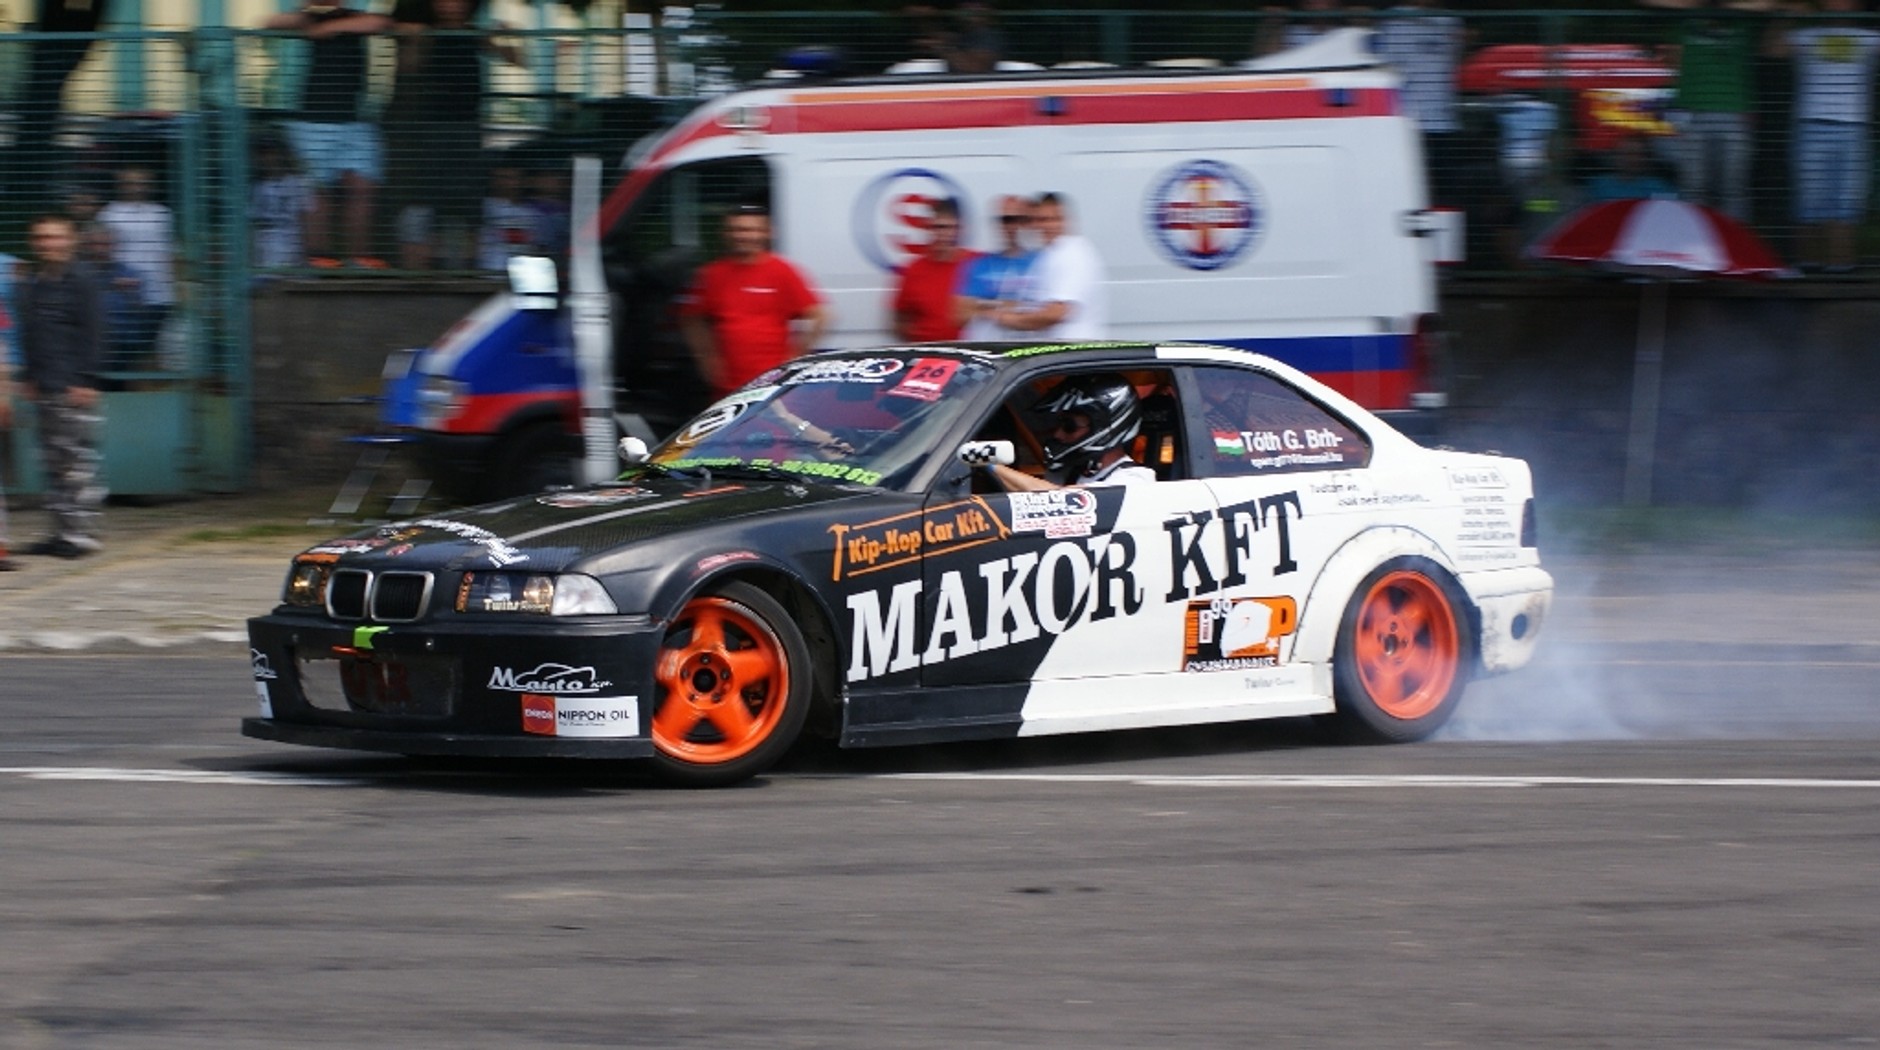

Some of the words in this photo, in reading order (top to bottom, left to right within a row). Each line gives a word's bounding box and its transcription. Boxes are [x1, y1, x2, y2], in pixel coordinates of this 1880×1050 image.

[917, 366, 945, 380] 26
[1241, 431, 1282, 453] Tóth
[1283, 429, 1304, 450] G.
[925, 520, 954, 544] Car
[956, 508, 990, 537] Kft.
[846, 530, 1145, 683] MAKOR
[1163, 491, 1303, 604] KFT
[558, 710, 606, 721] NIPPON
[609, 710, 630, 721] OIL
